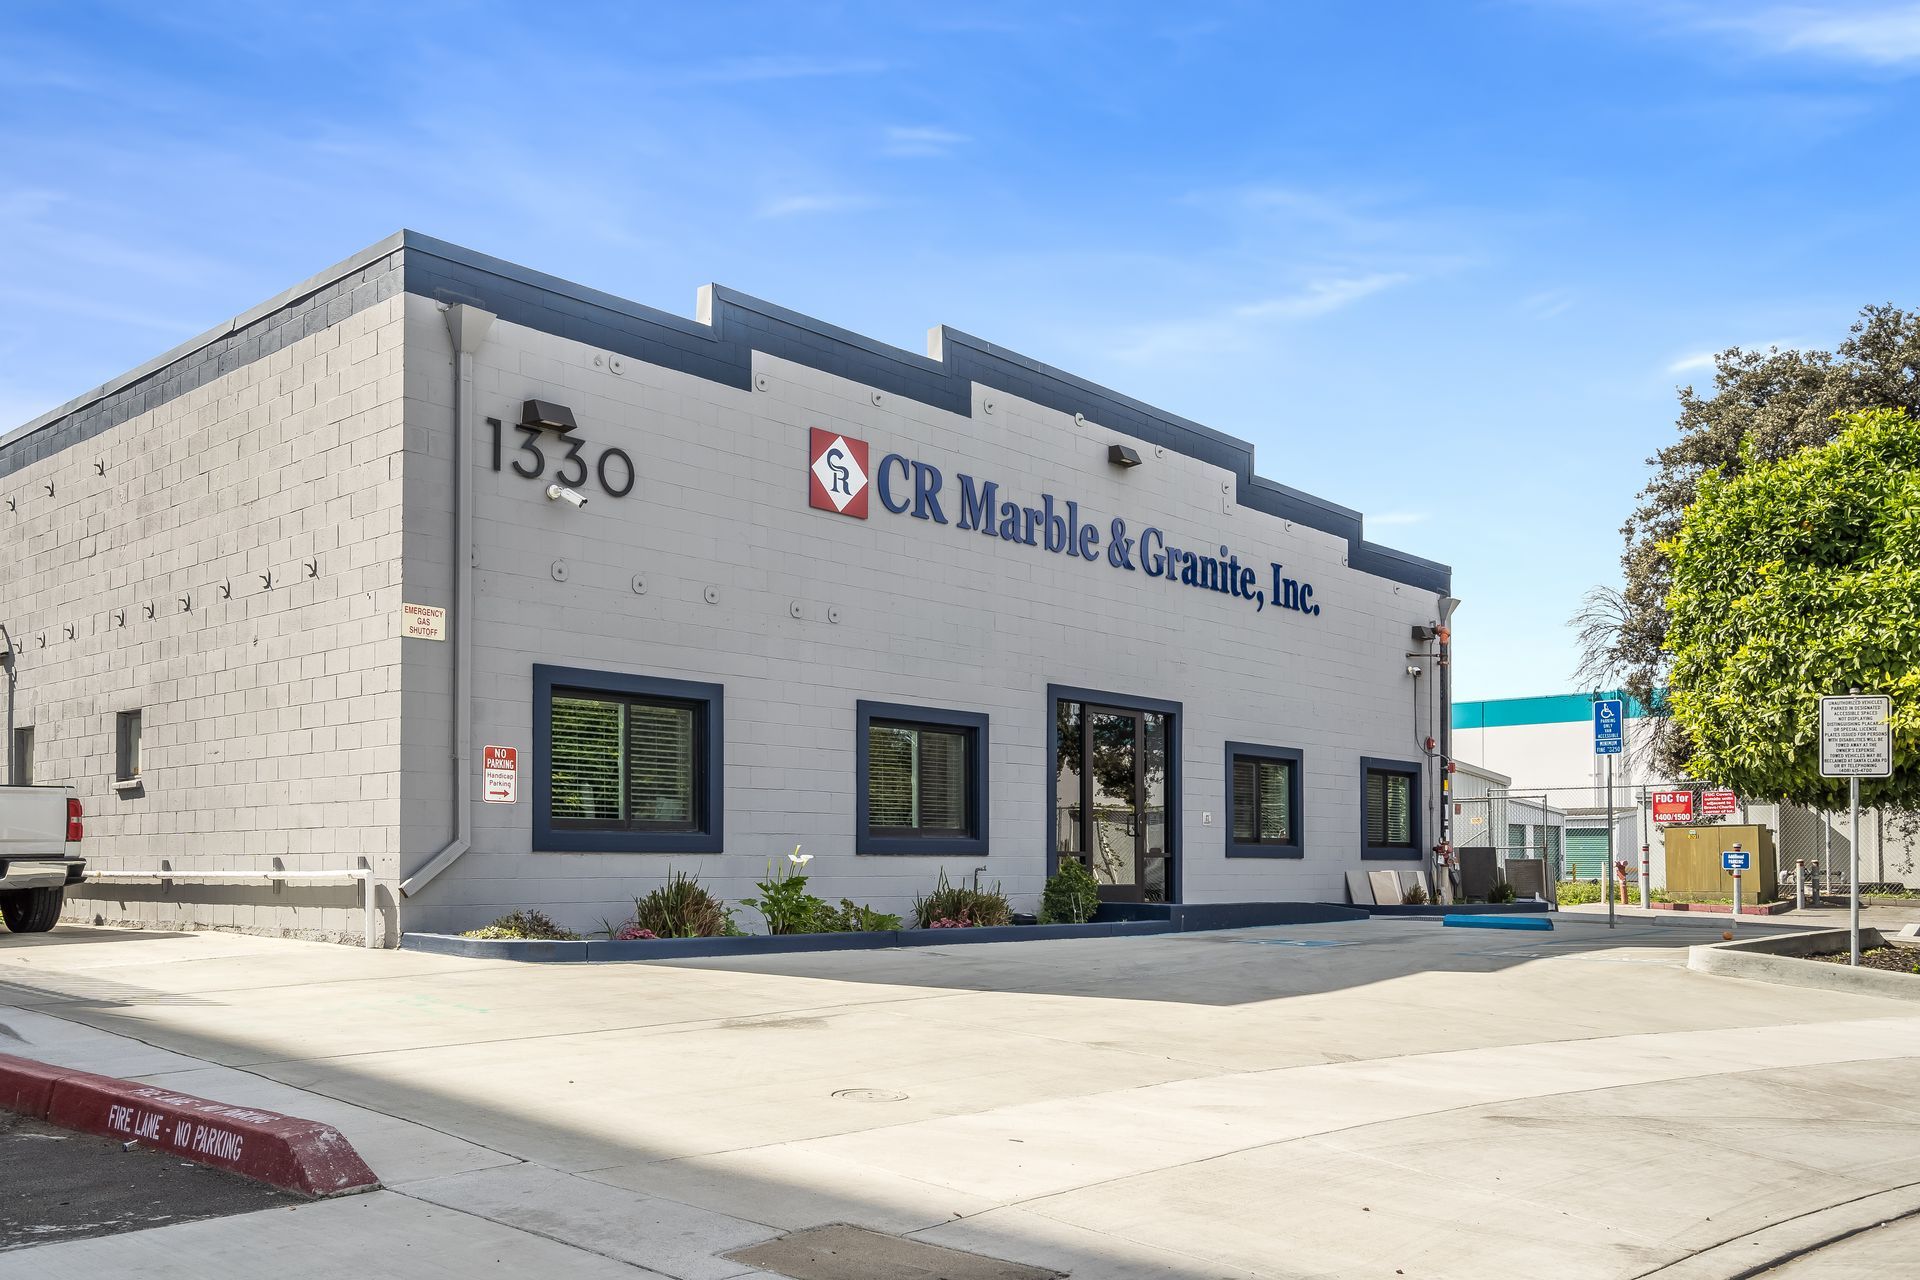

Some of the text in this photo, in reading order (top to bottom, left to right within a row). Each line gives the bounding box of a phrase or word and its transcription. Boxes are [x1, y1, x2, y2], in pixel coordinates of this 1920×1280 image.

[487, 416, 635, 498] 1330
[877, 453, 1321, 617] CR Marble & Granite, Inc.
[404, 605, 444, 618] EMERGENCY
[417, 617, 431, 626] GAS
[409, 625, 438, 636] SHUTOFF
[494, 748, 507, 759] NO
[487, 758, 514, 770] PARKING
[487, 772, 514, 781] Handicap
[489, 780, 512, 789] Parking
[1655, 793, 1689, 803] FDC for
[1655, 813, 1691, 821] 1400/1500
[108, 1104, 134, 1133] FIRE
[134, 1110, 164, 1140] LANE
[174, 1121, 192, 1148] NO
[192, 1125, 244, 1161] PARKING
